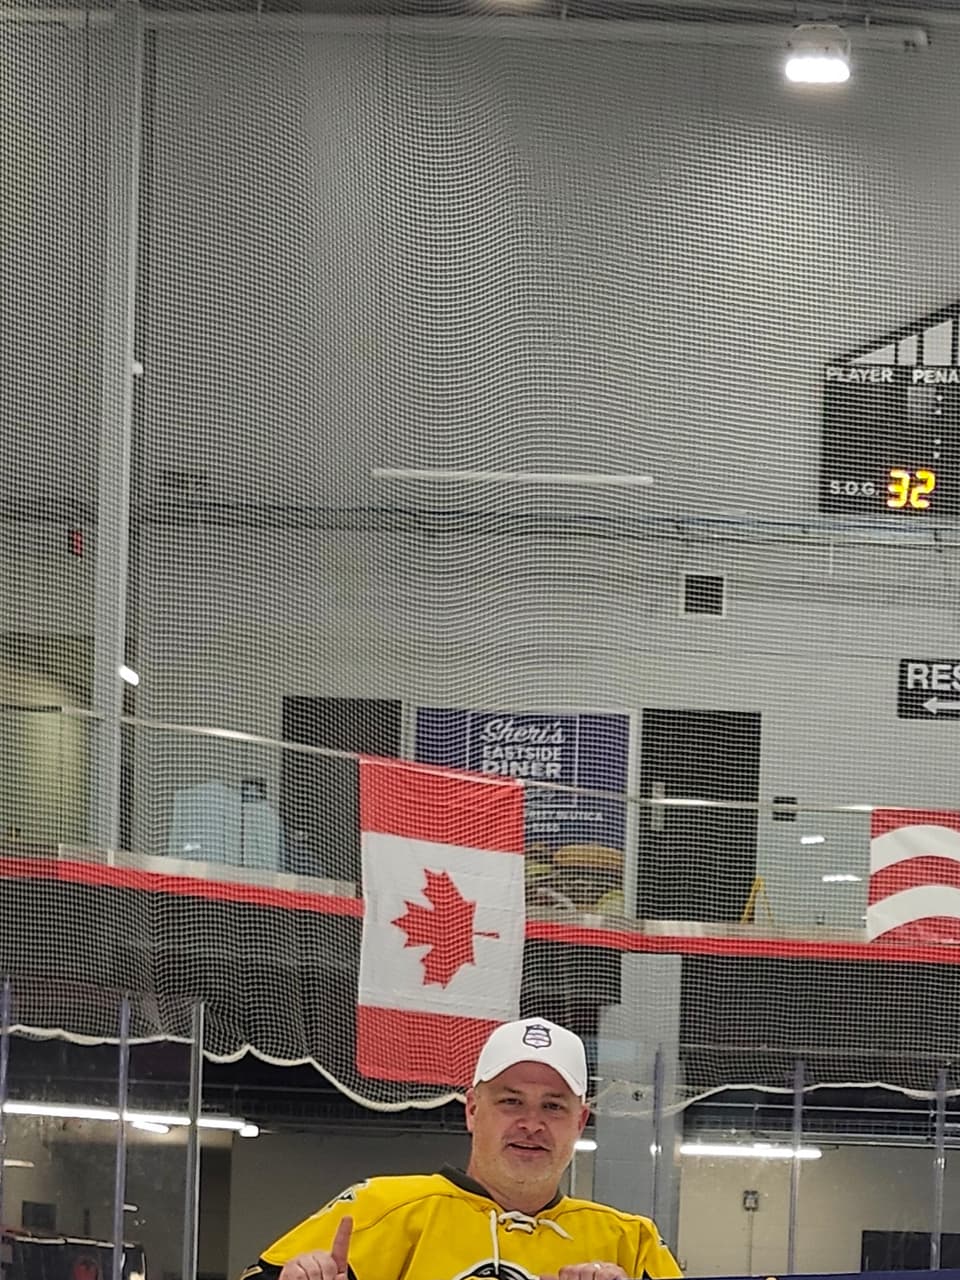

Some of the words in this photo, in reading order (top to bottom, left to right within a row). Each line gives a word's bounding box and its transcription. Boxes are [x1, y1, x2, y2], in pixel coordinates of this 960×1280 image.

[825, 366, 894, 383] PLAYER
[886, 468, 936, 509] 32
[483, 745, 562, 762] EASTSIDE
[482, 759, 562, 778] DINER
